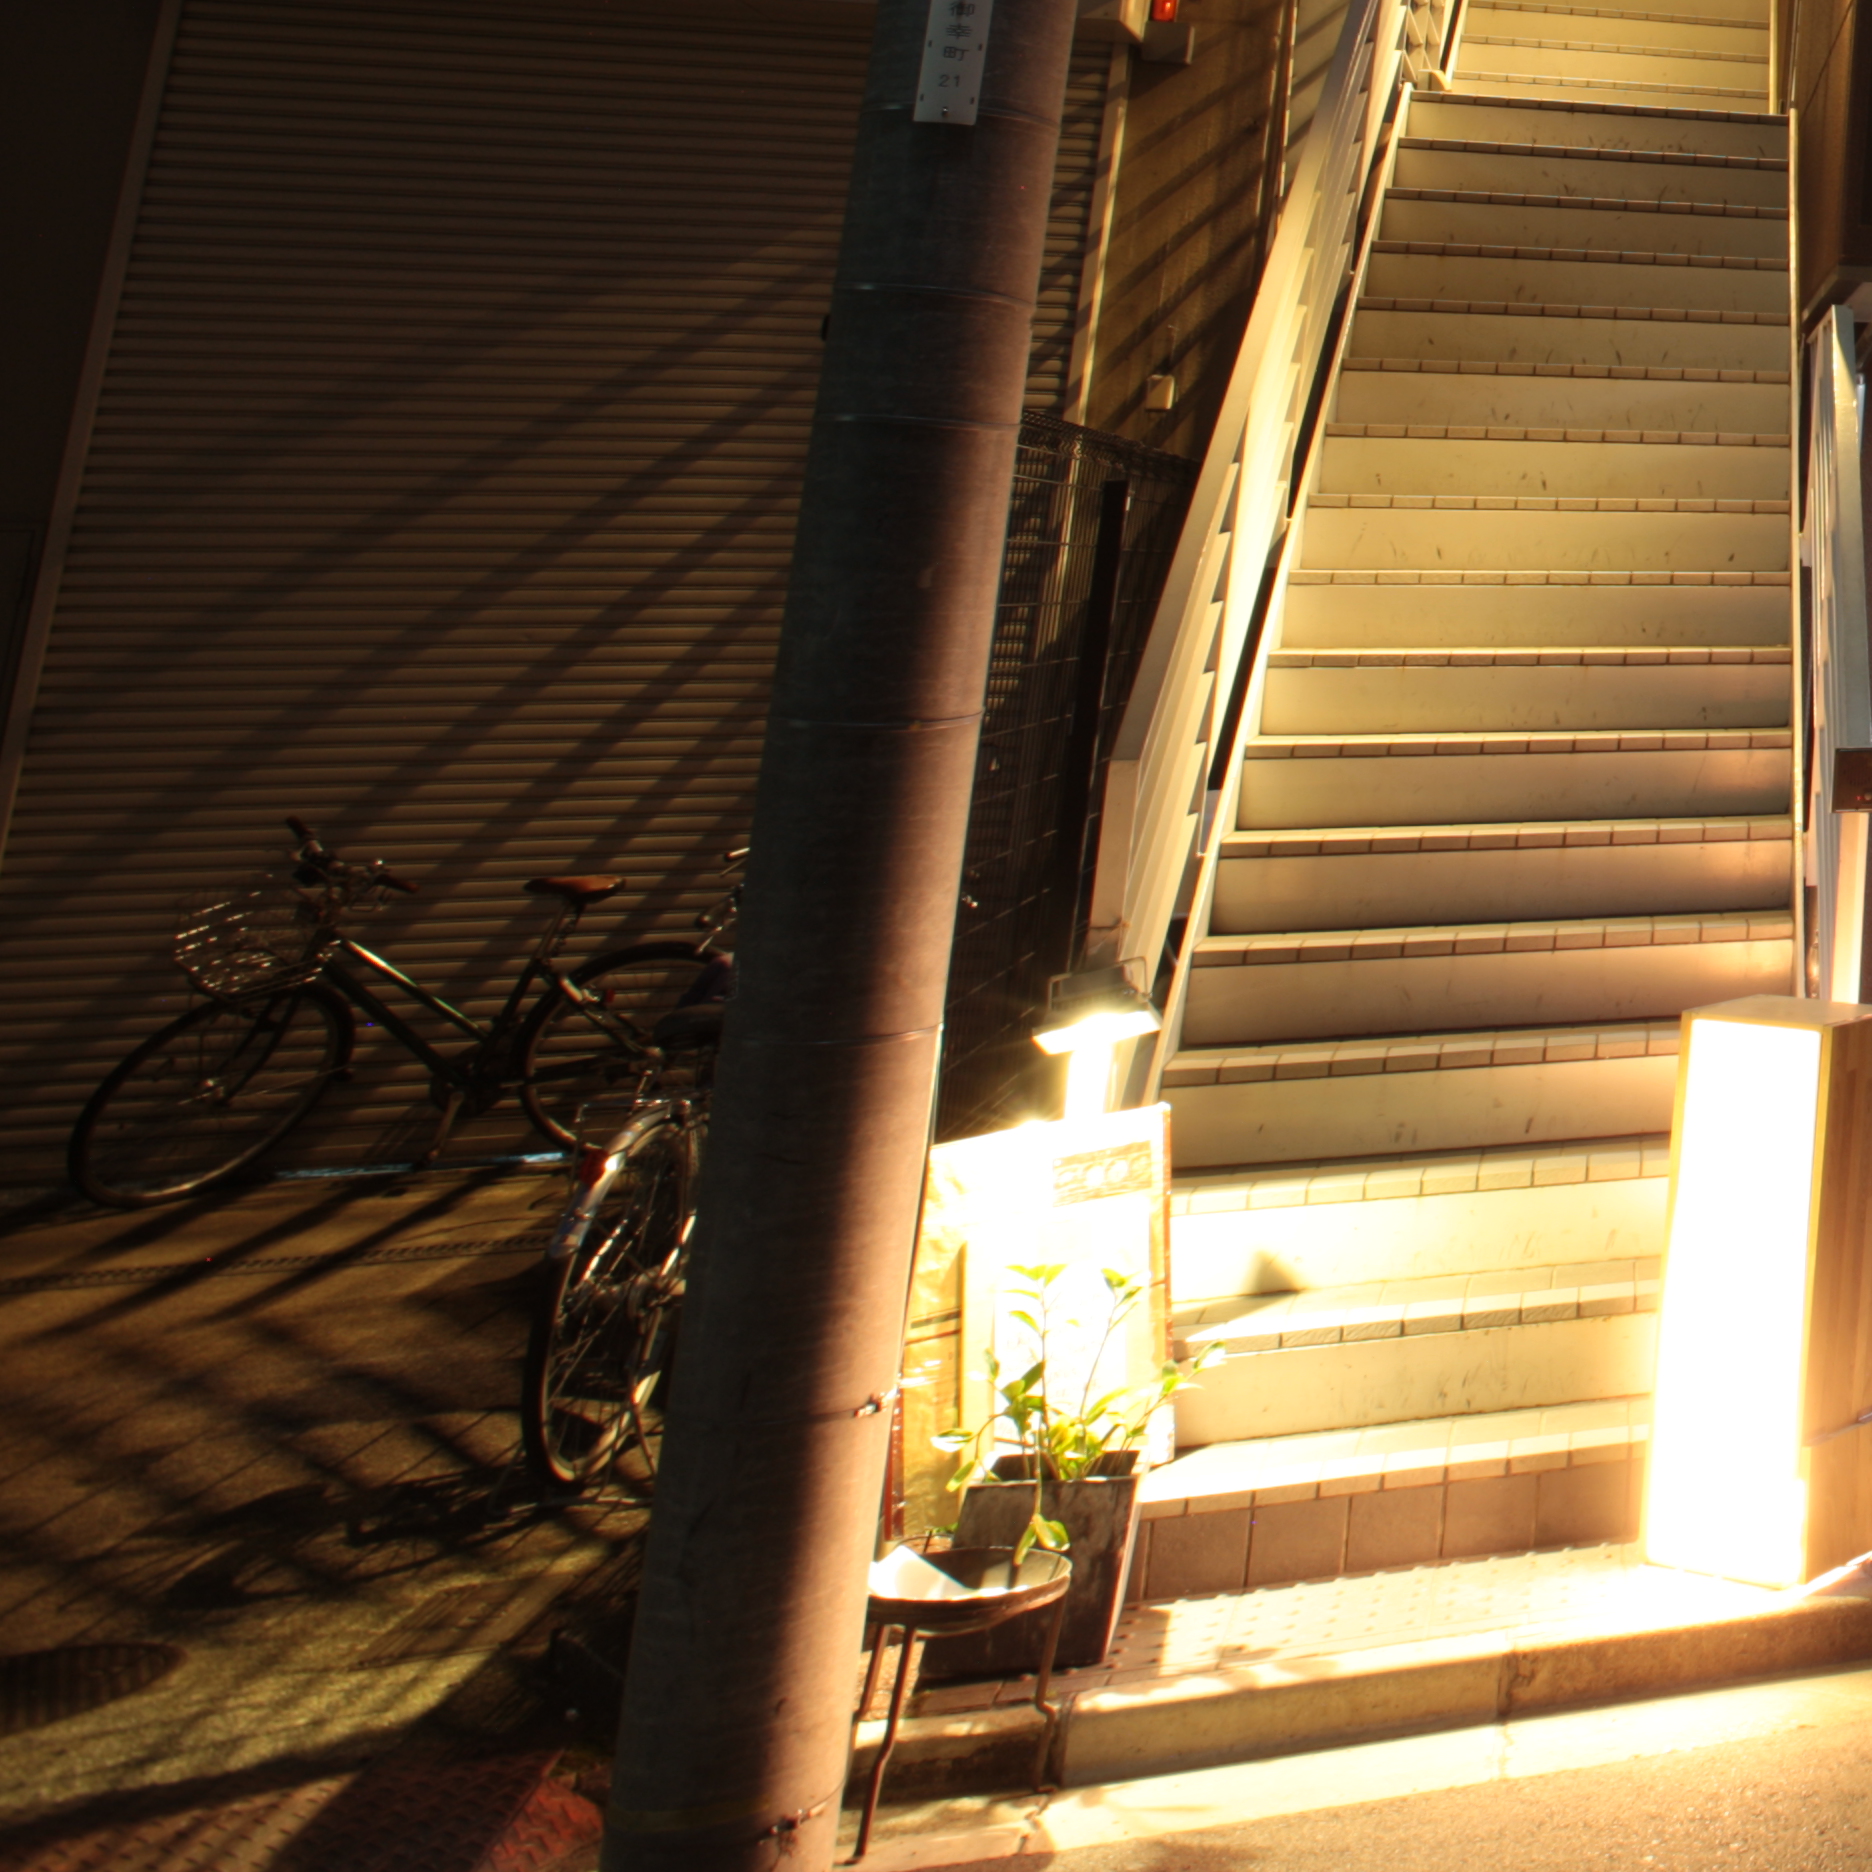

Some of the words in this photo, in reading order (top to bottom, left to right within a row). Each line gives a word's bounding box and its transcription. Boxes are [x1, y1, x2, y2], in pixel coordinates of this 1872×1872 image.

[943, 1, 975, 61] 御幸町
[938, 75, 961, 88] 21
